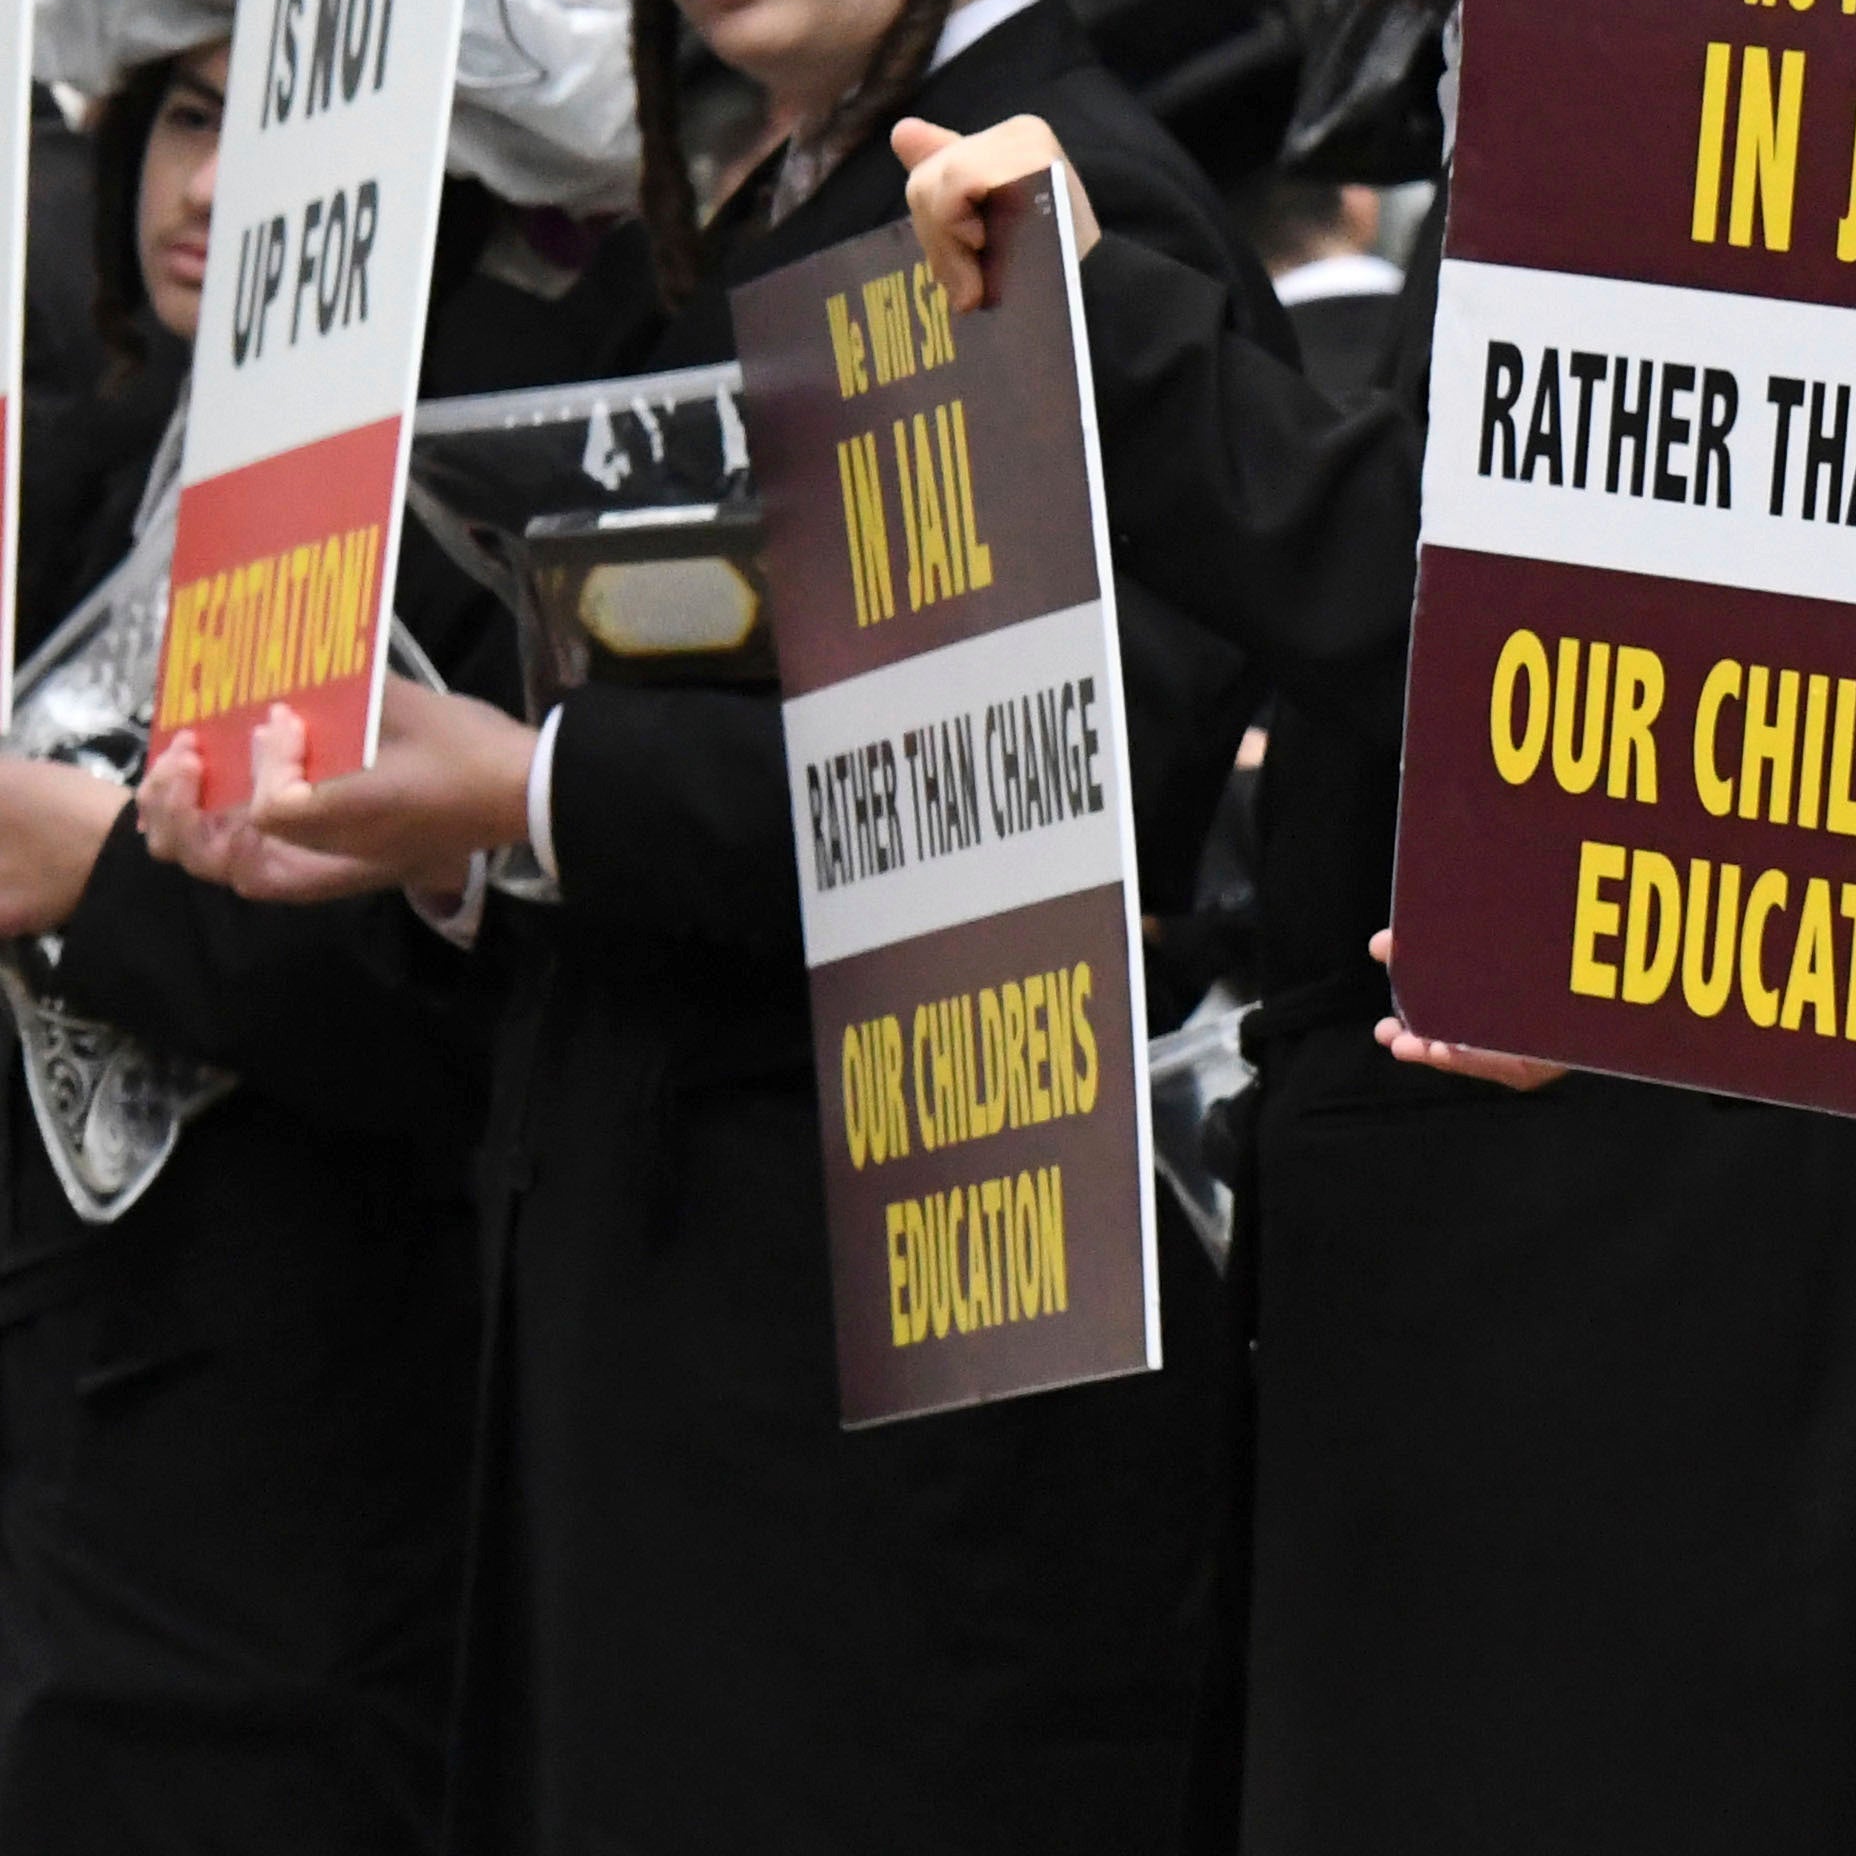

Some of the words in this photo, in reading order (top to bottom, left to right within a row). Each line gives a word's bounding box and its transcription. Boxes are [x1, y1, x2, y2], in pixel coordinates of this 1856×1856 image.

[1692, 42, 1805, 252] IN
[232, 214, 287, 368] UP
[291, 180, 378, 343] FOR
[827, 293, 870, 400] We
[863, 270, 916, 386] Will
[837, 433, 893, 627] IN
[893, 400, 993, 612] JAIL
[1479, 341, 1738, 509] RATHER
[160, 525, 380, 728] NEGOTIATION!
[1490, 629, 1665, 804] OUR
[807, 738, 903, 890] RATHER
[904, 713, 979, 860] THAN
[985, 678, 1103, 840] CHANGE
[842, 1010, 910, 1169] OUR
[912, 962, 1099, 1152] CHILDRENS
[886, 1165, 1069, 1348] EDUCATION
